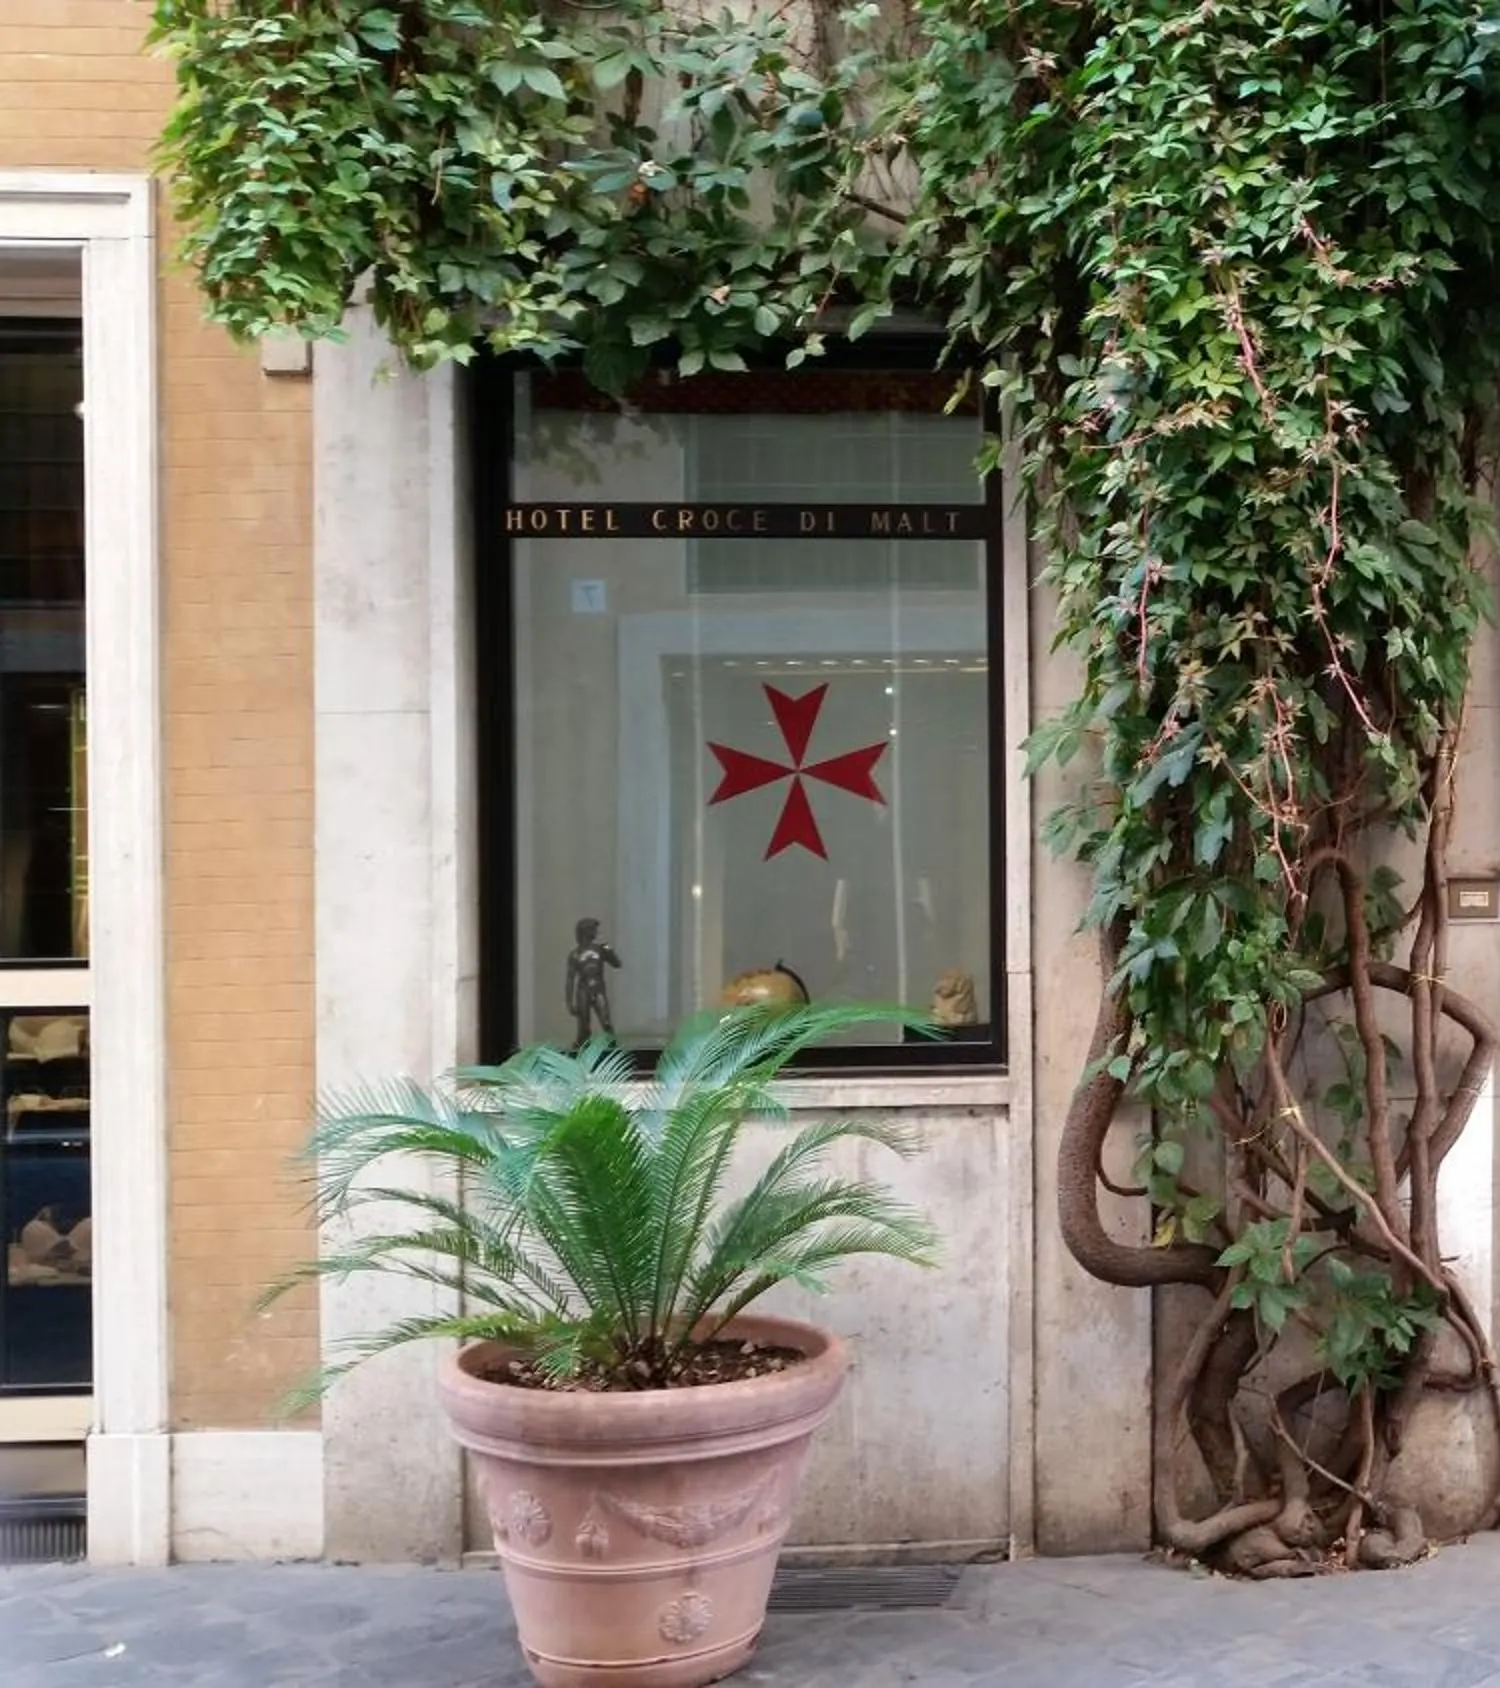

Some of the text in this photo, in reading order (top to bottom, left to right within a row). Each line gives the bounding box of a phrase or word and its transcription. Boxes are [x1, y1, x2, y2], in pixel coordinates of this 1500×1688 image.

[505, 509, 620, 532] HOTEL
[651, 509, 769, 532] CROCE
[800, 510, 835, 532] DI
